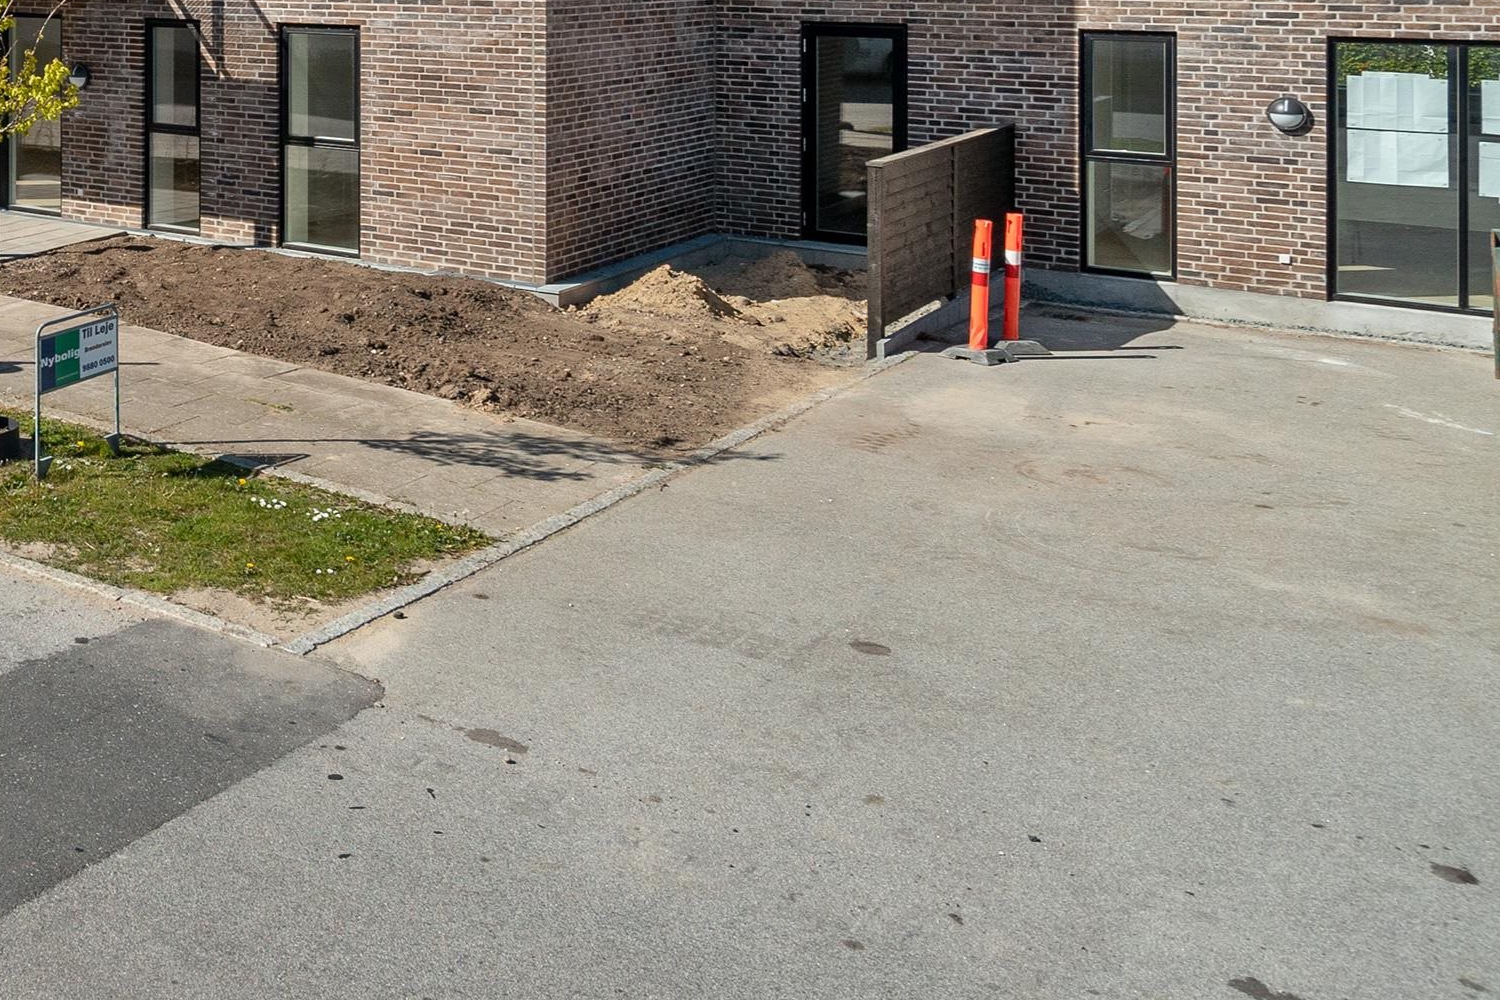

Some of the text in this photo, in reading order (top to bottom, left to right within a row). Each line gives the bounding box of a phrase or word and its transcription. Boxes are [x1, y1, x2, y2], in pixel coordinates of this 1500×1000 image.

[82, 322, 114, 339] Til Leje
[40, 348, 80, 367] Nybolig
[99, 355, 115, 366] 0500
